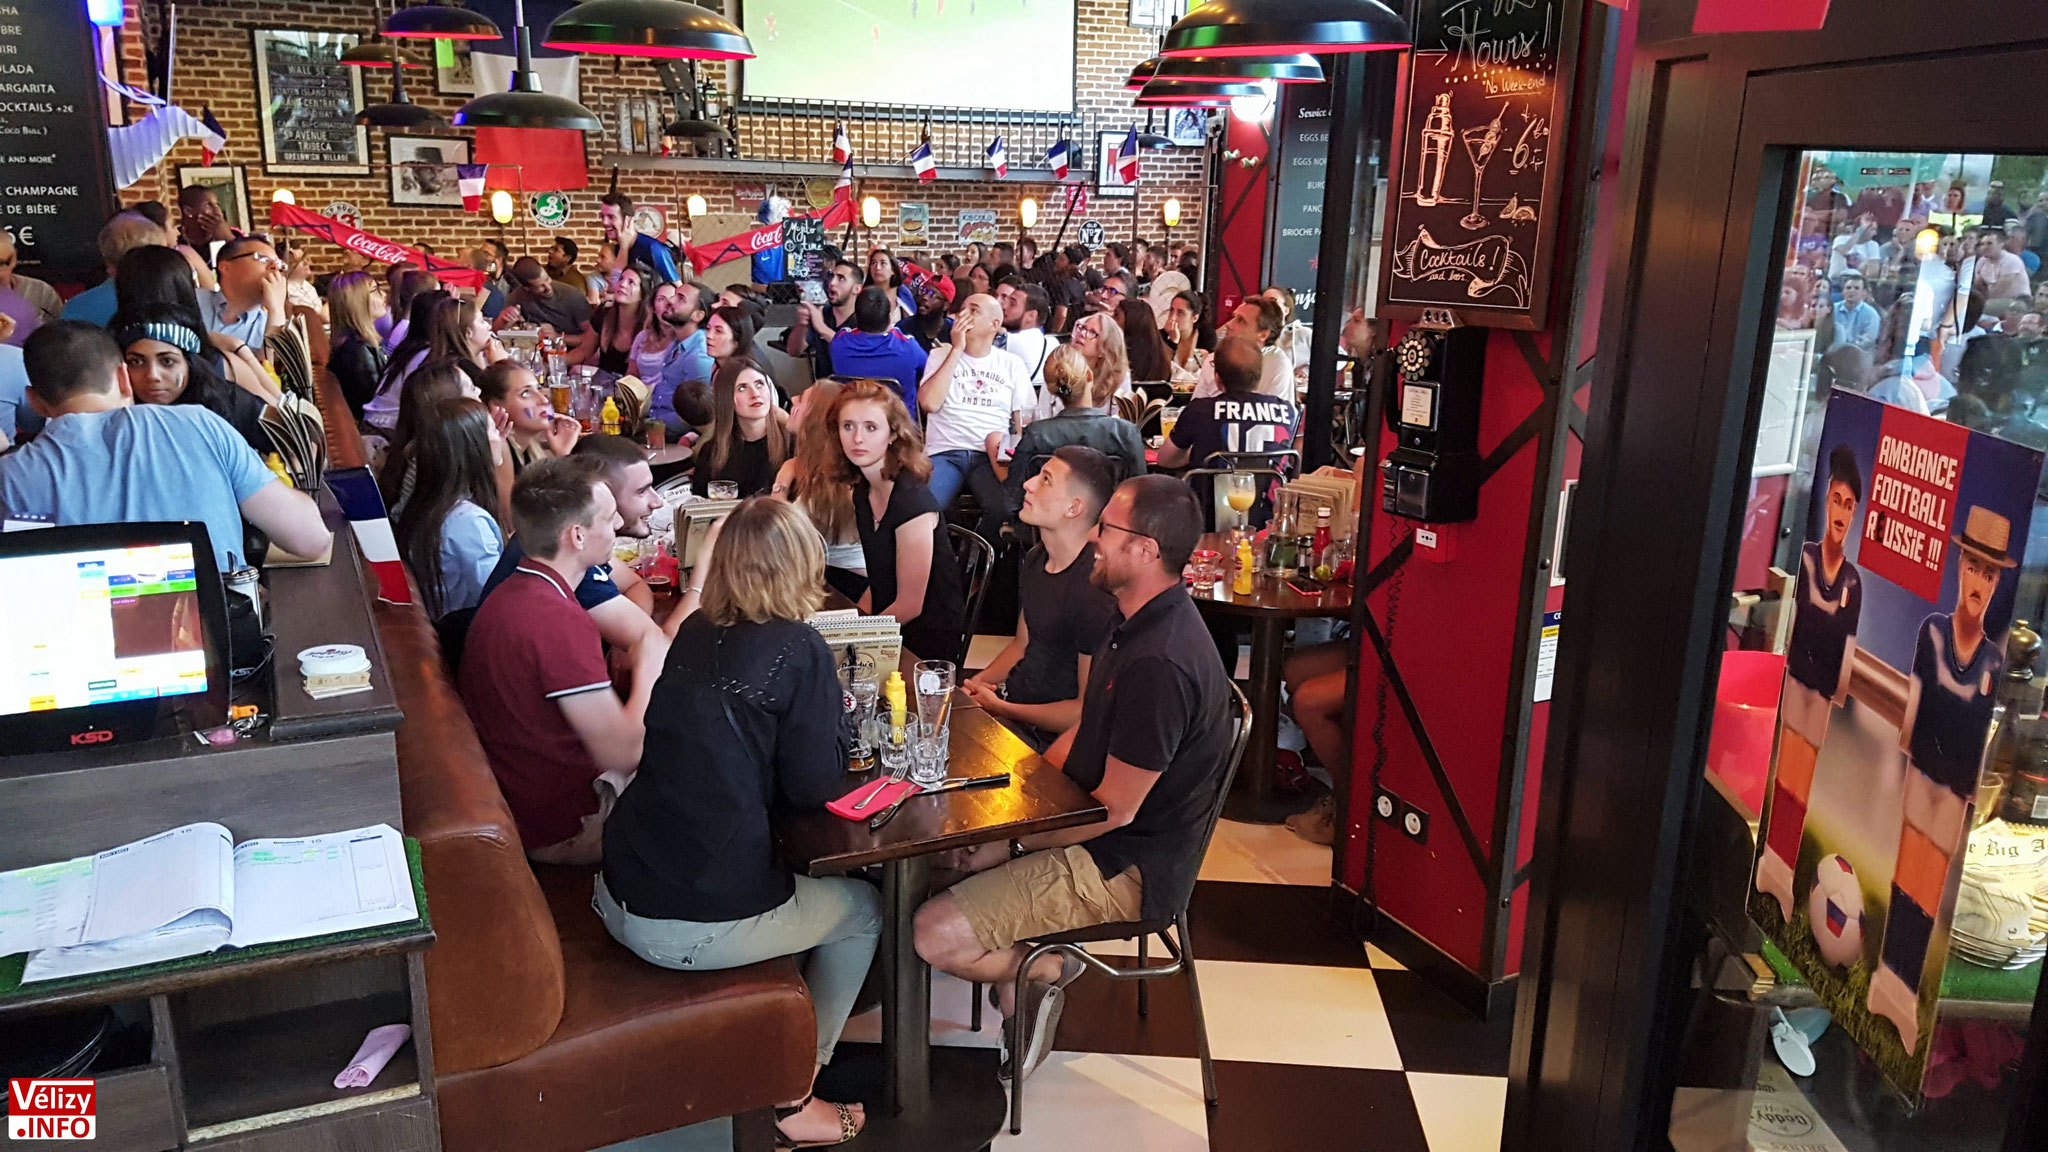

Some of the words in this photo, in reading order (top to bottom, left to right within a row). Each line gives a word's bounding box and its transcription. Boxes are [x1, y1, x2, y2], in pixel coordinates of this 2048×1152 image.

[288, 65, 312, 74] WALL
[295, 131, 328, 140] AVENUE
[1299, 133, 1319, 142] EGGS
[298, 142, 333, 151] TRIBECA
[1293, 157, 1312, 166] EGGS
[6, 186, 79, 196] CHAMPAGNE
[7, 204, 22, 214] DE
[26, 202, 58, 214] BIÈRE
[1282, 228, 1313, 237] BRIOCHE
[1214, 401, 1291, 425] FRANCE
[1878, 435, 1959, 491] AMBIANCE
[1871, 473, 1946, 532] FOOTBALL
[70, 730, 114, 745] KSD
[1984, 838, 2020, 858] Big
